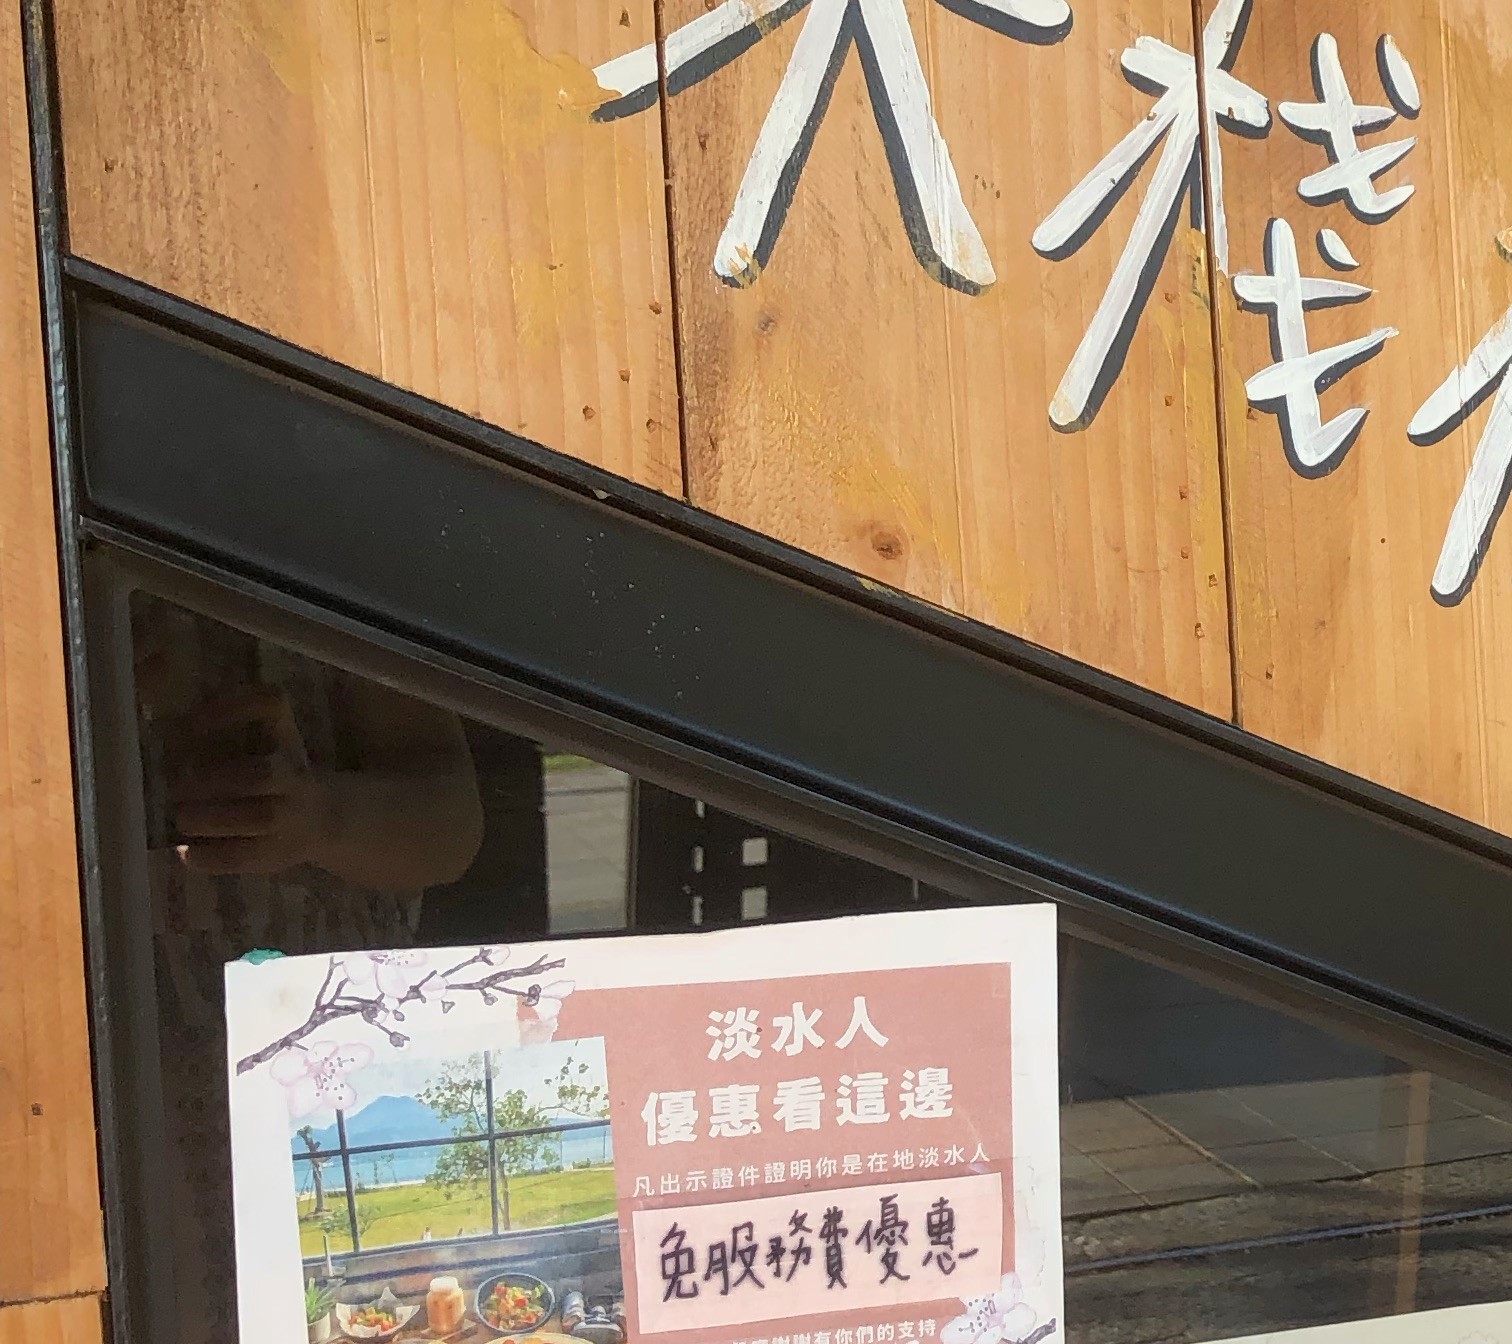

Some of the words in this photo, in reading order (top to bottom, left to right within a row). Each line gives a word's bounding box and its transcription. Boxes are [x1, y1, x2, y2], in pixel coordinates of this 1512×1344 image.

[705, 995, 890, 1063] 淡水人
[640, 1067, 955, 1147] 優惠看這邊
[632, 1143, 991, 1198] 凡出示證件證明你是在地淡水人
[660, 1193, 979, 1302] 免服務費優惠
